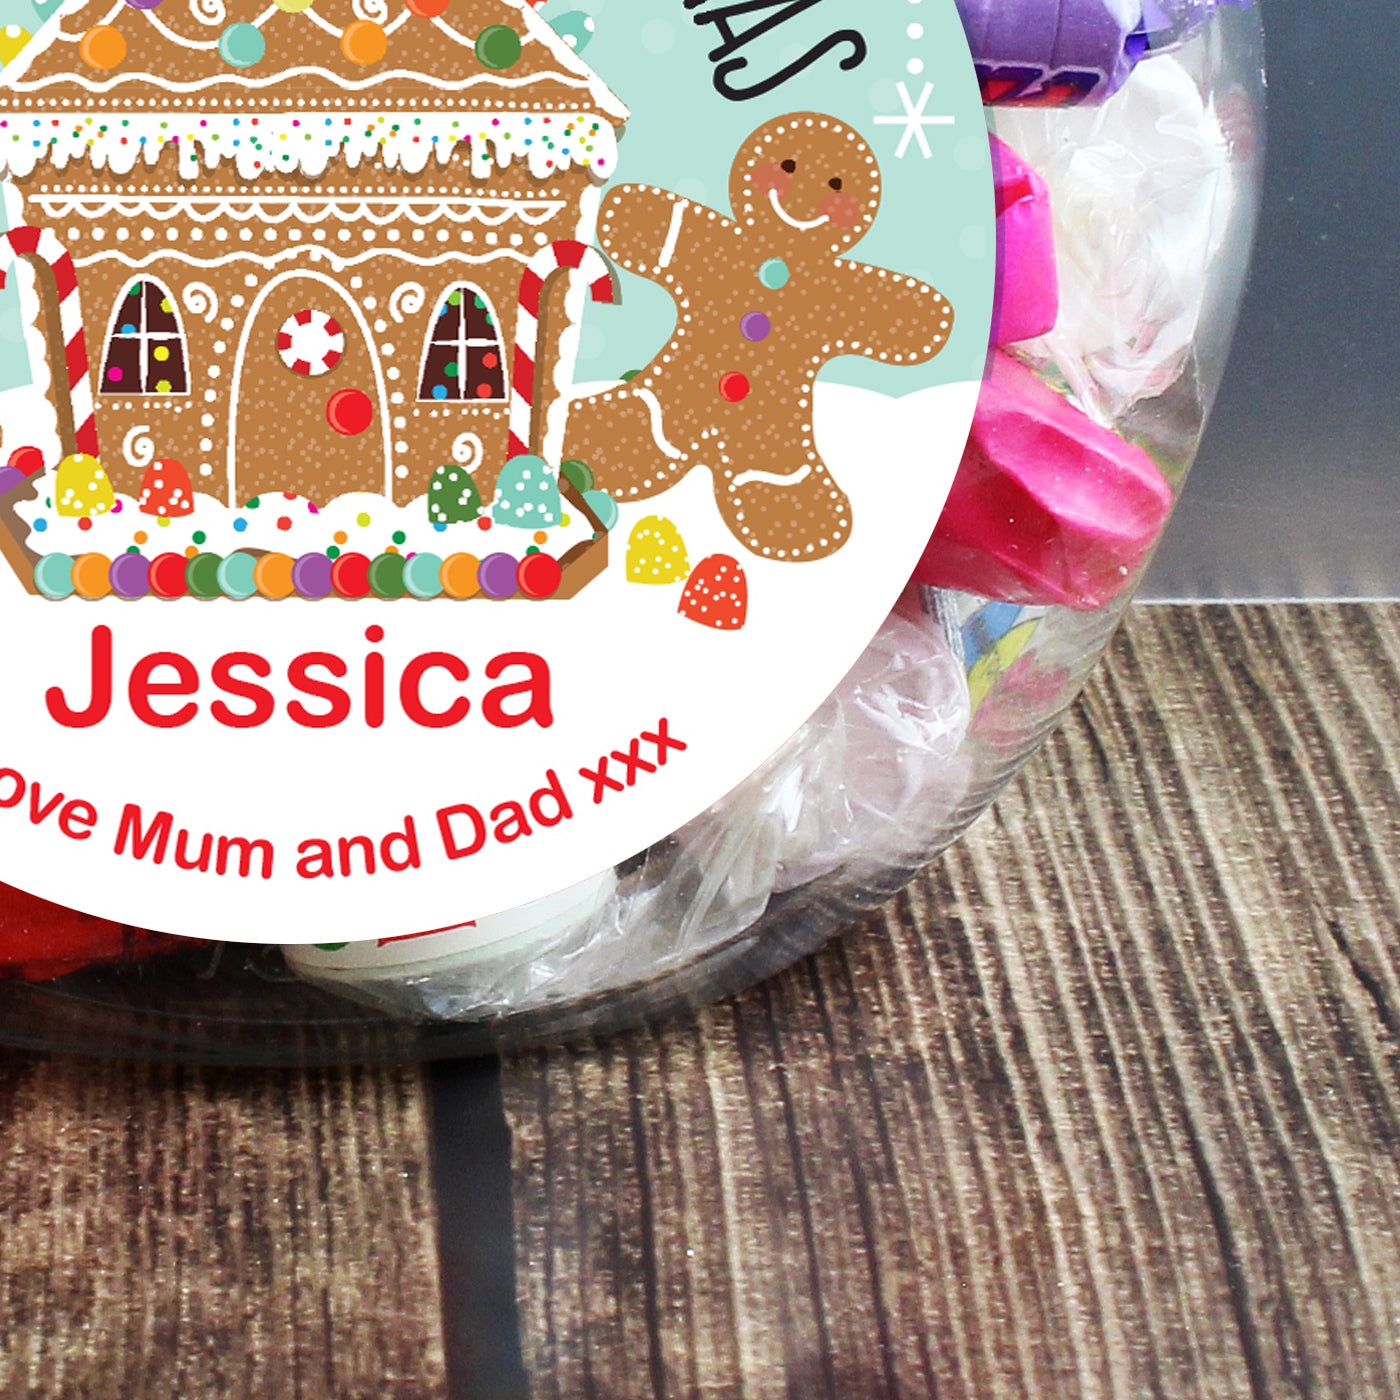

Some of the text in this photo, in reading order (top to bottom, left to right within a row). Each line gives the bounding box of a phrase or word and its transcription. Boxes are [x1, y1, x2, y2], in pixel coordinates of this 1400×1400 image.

[45, 624, 554, 729] Jessica
[113, 803, 274, 880] Mum
[295, 814, 421, 880] and
[435, 768, 574, 861] Dad
[578, 717, 688, 805] xxx
